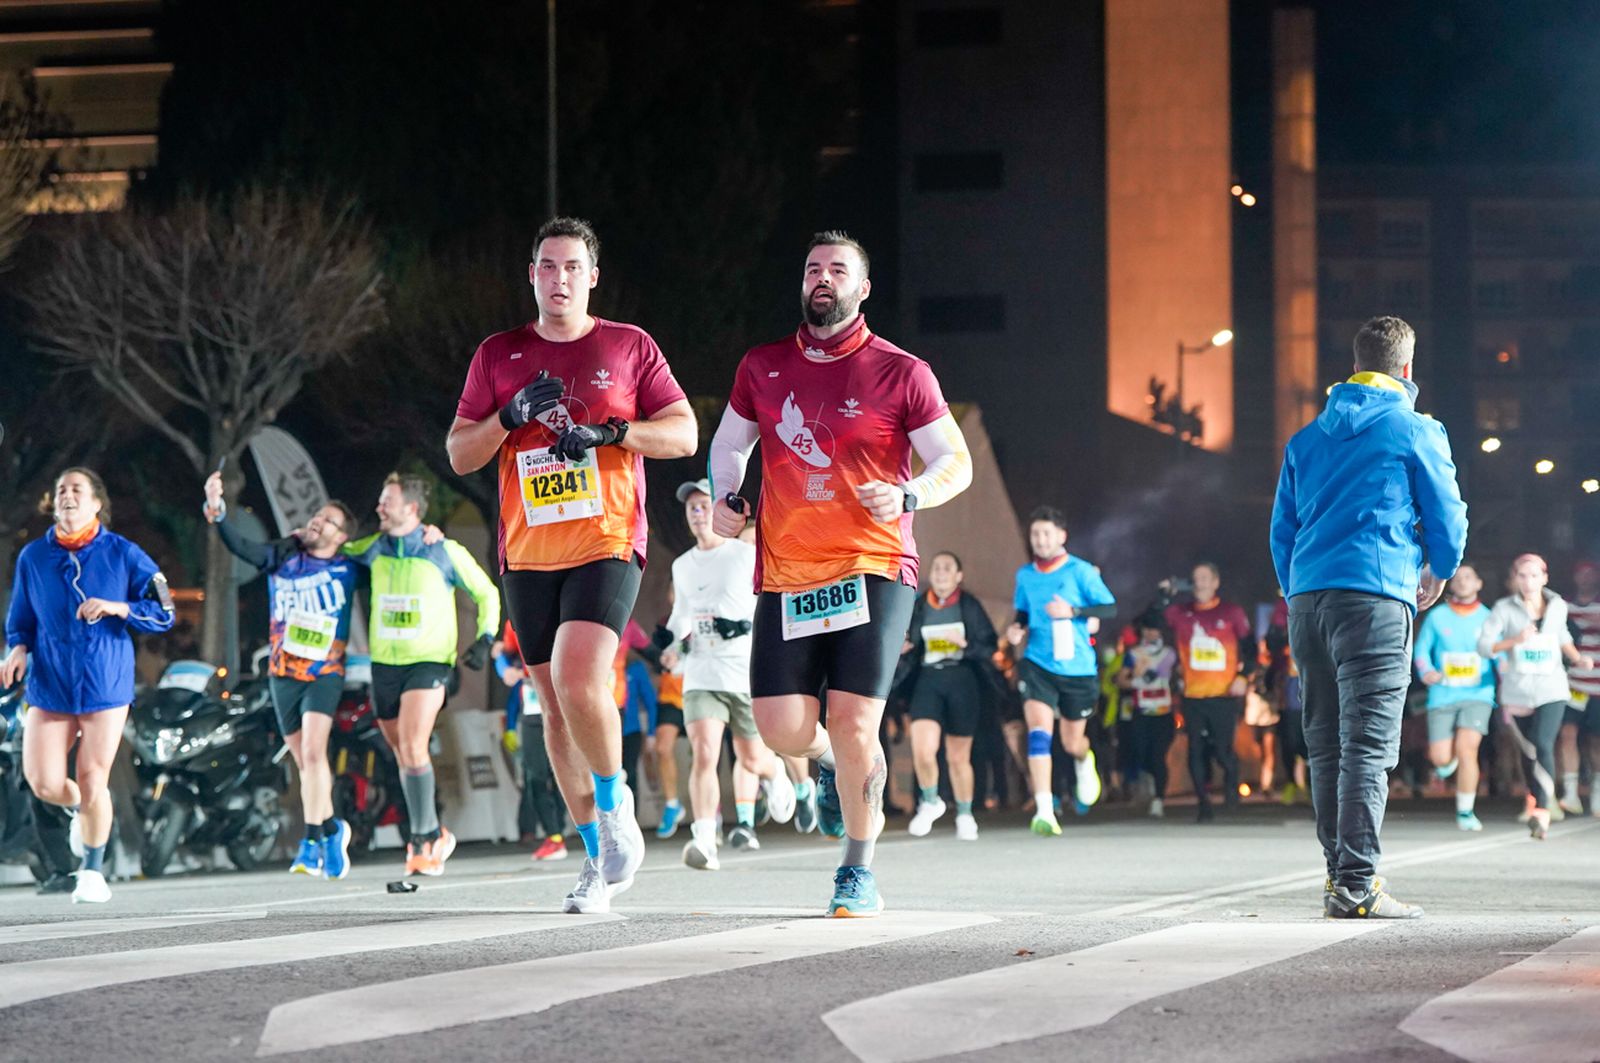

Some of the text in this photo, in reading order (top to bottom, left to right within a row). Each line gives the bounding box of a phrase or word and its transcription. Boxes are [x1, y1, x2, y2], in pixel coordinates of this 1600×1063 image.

[546, 411, 568, 431] 43
[791, 433, 813, 455] 43
[532, 454, 555, 465] NOCHE
[527, 466, 540, 477] SAN
[530, 469, 588, 499] 12341
[807, 480, 825, 490] SAN
[791, 582, 857, 616] 13686
